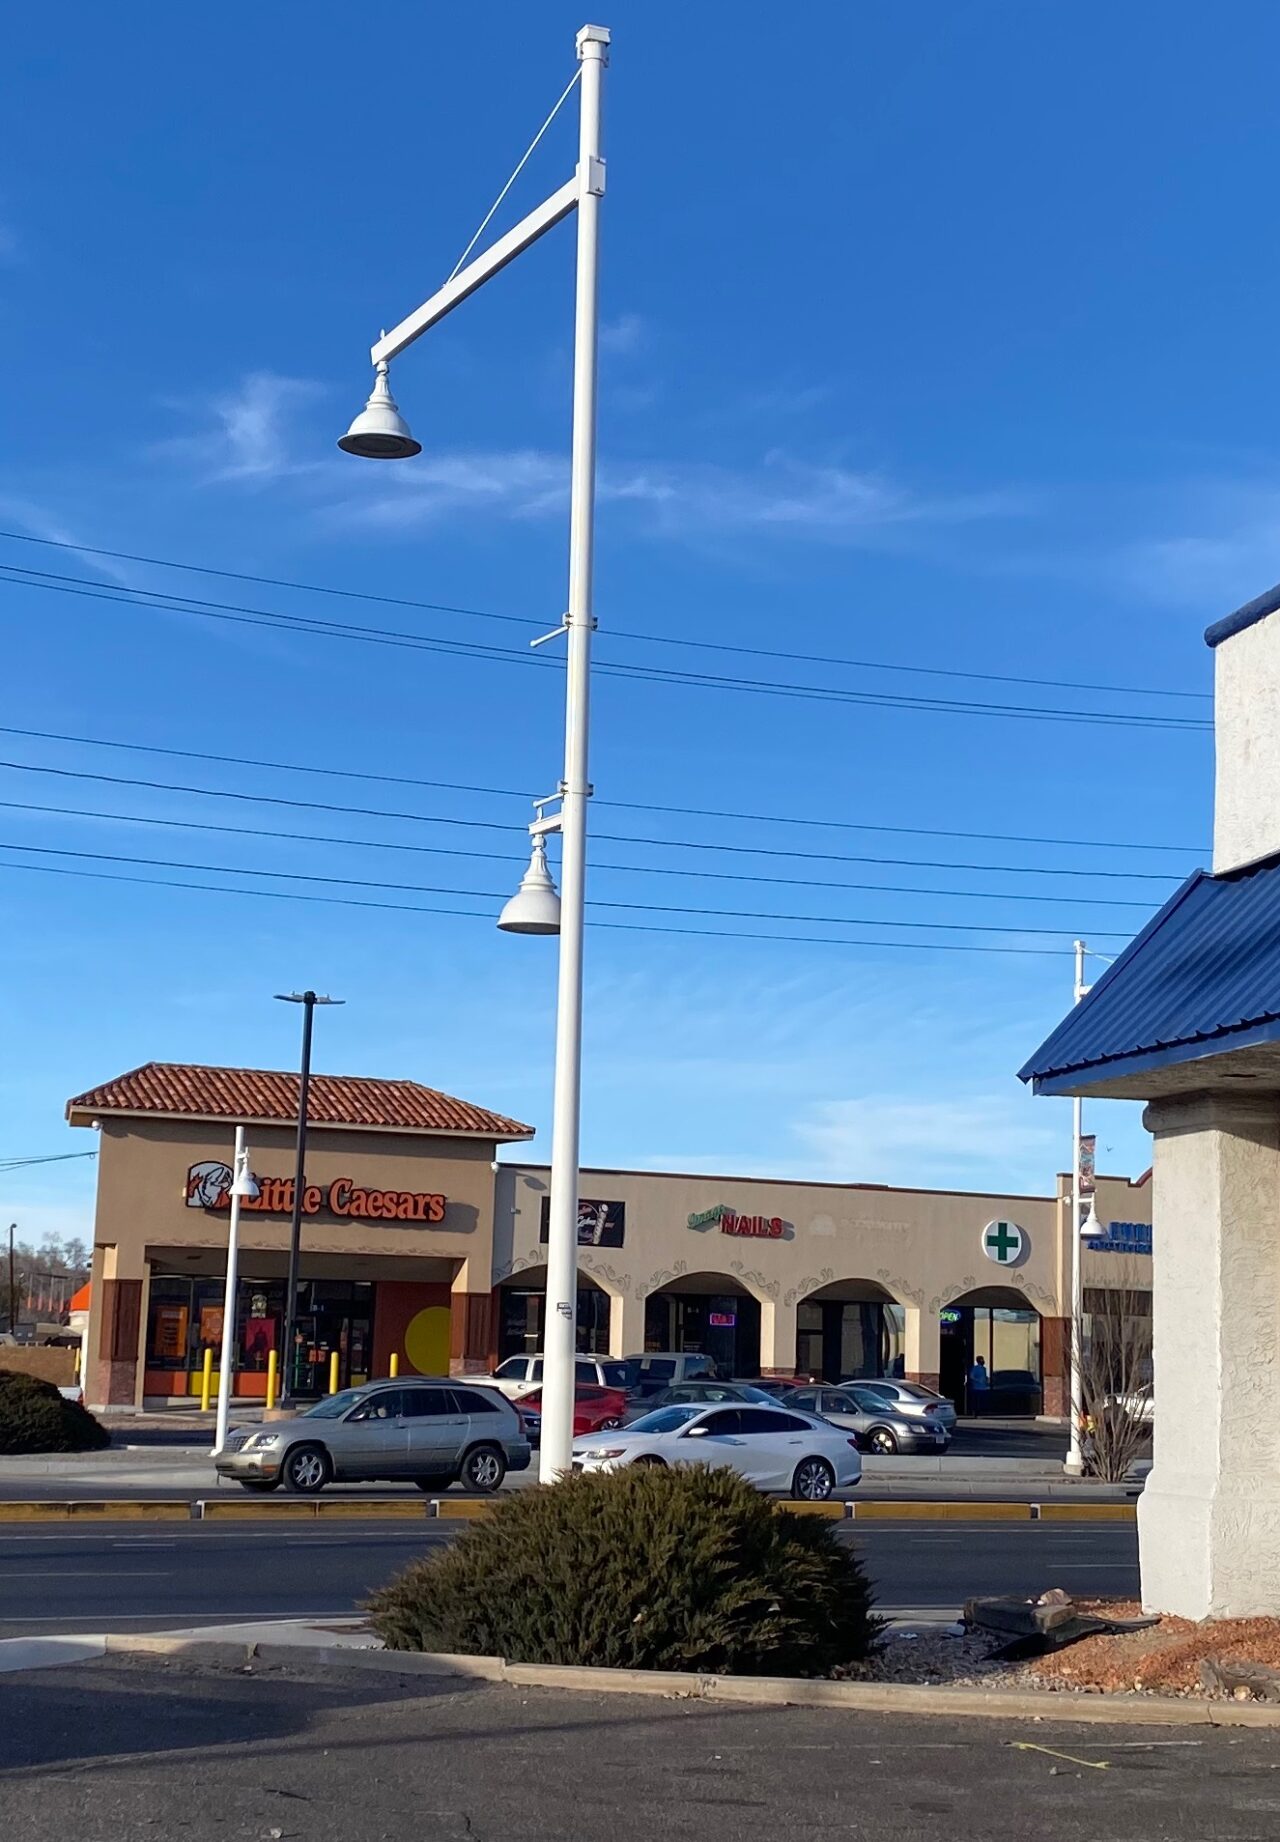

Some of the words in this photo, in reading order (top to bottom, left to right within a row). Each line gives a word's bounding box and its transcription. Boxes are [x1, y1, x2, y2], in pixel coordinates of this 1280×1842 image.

[240, 1174, 322, 1214] Litte
[329, 1178, 446, 1221] Caesars
[719, 1214, 784, 1238] NAILS
